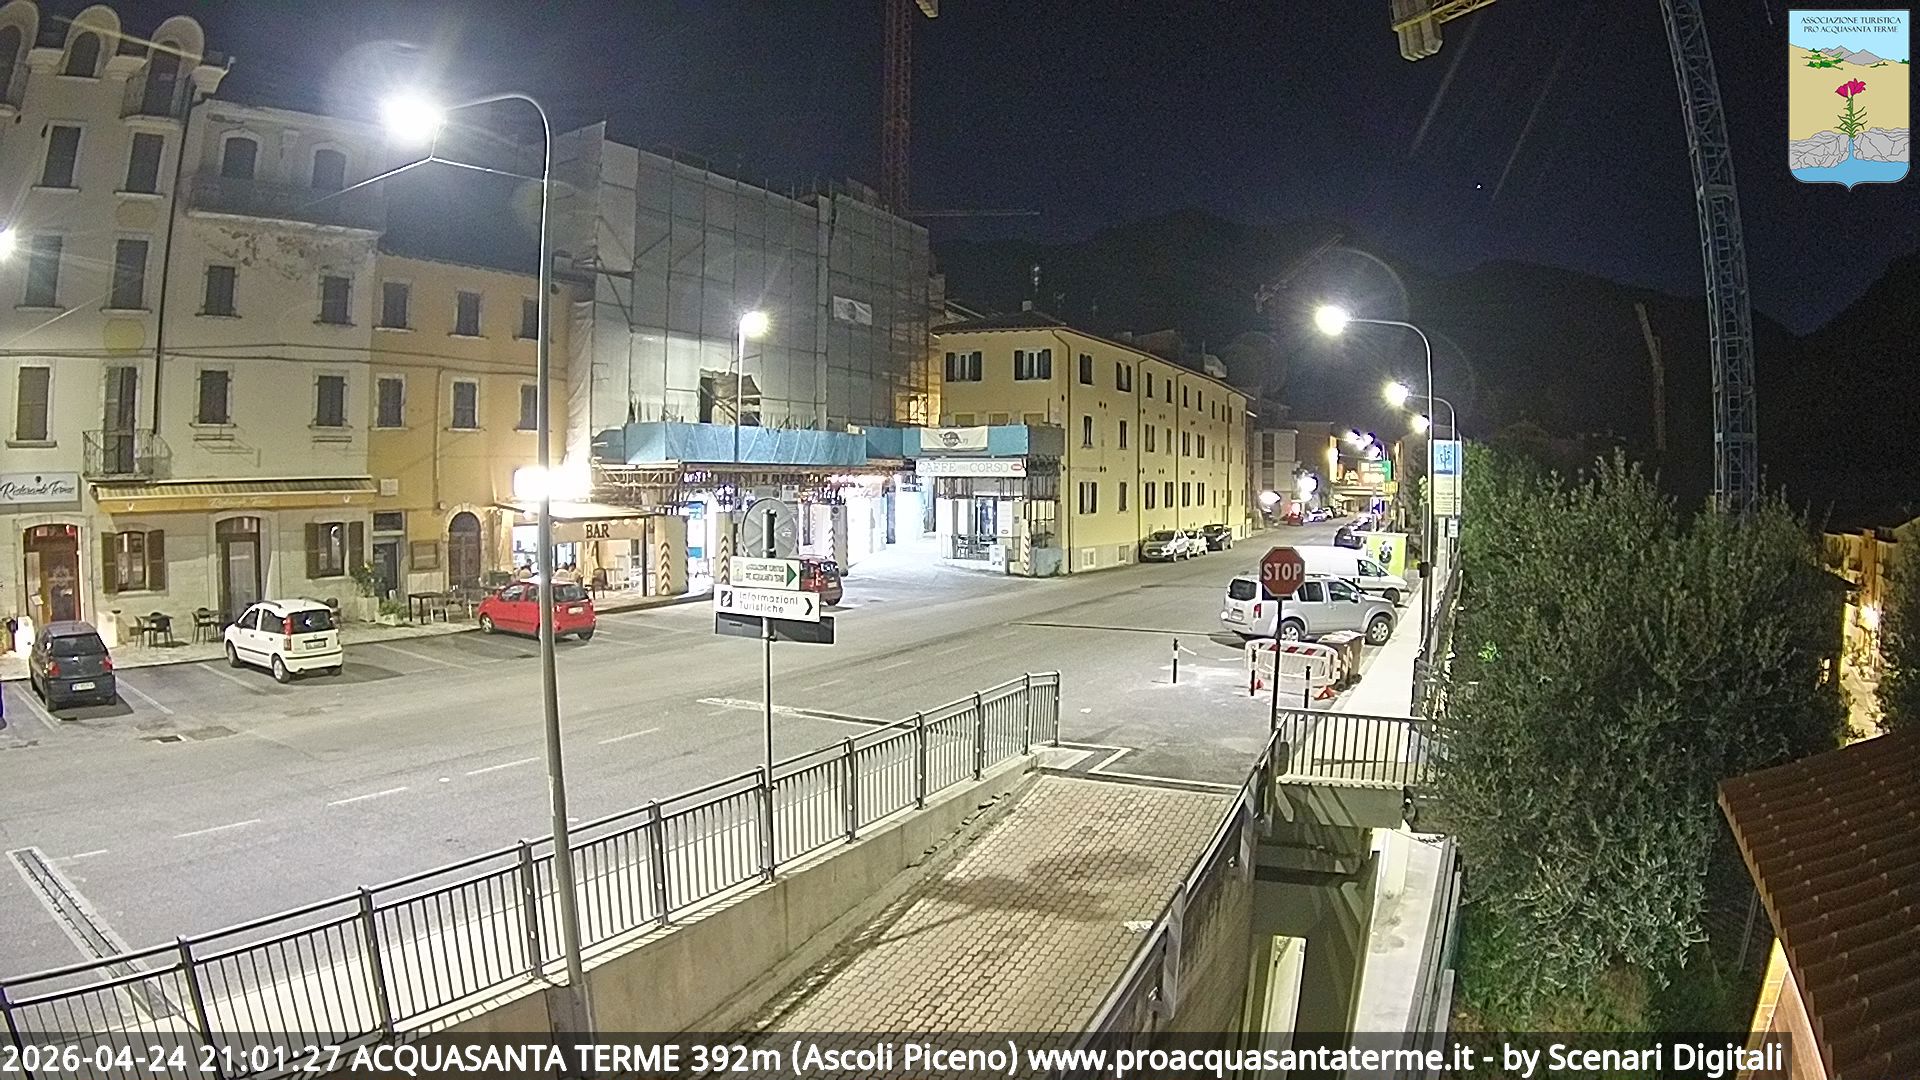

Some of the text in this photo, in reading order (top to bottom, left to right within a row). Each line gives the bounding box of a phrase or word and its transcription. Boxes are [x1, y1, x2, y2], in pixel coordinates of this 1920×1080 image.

[969, 462, 1009, 473] CORSO
[585, 523, 610, 539] BAR
[1263, 562, 1302, 581] STOP
[739, 591, 798, 605] Informazioni
[739, 600, 784, 614] Turistiche
